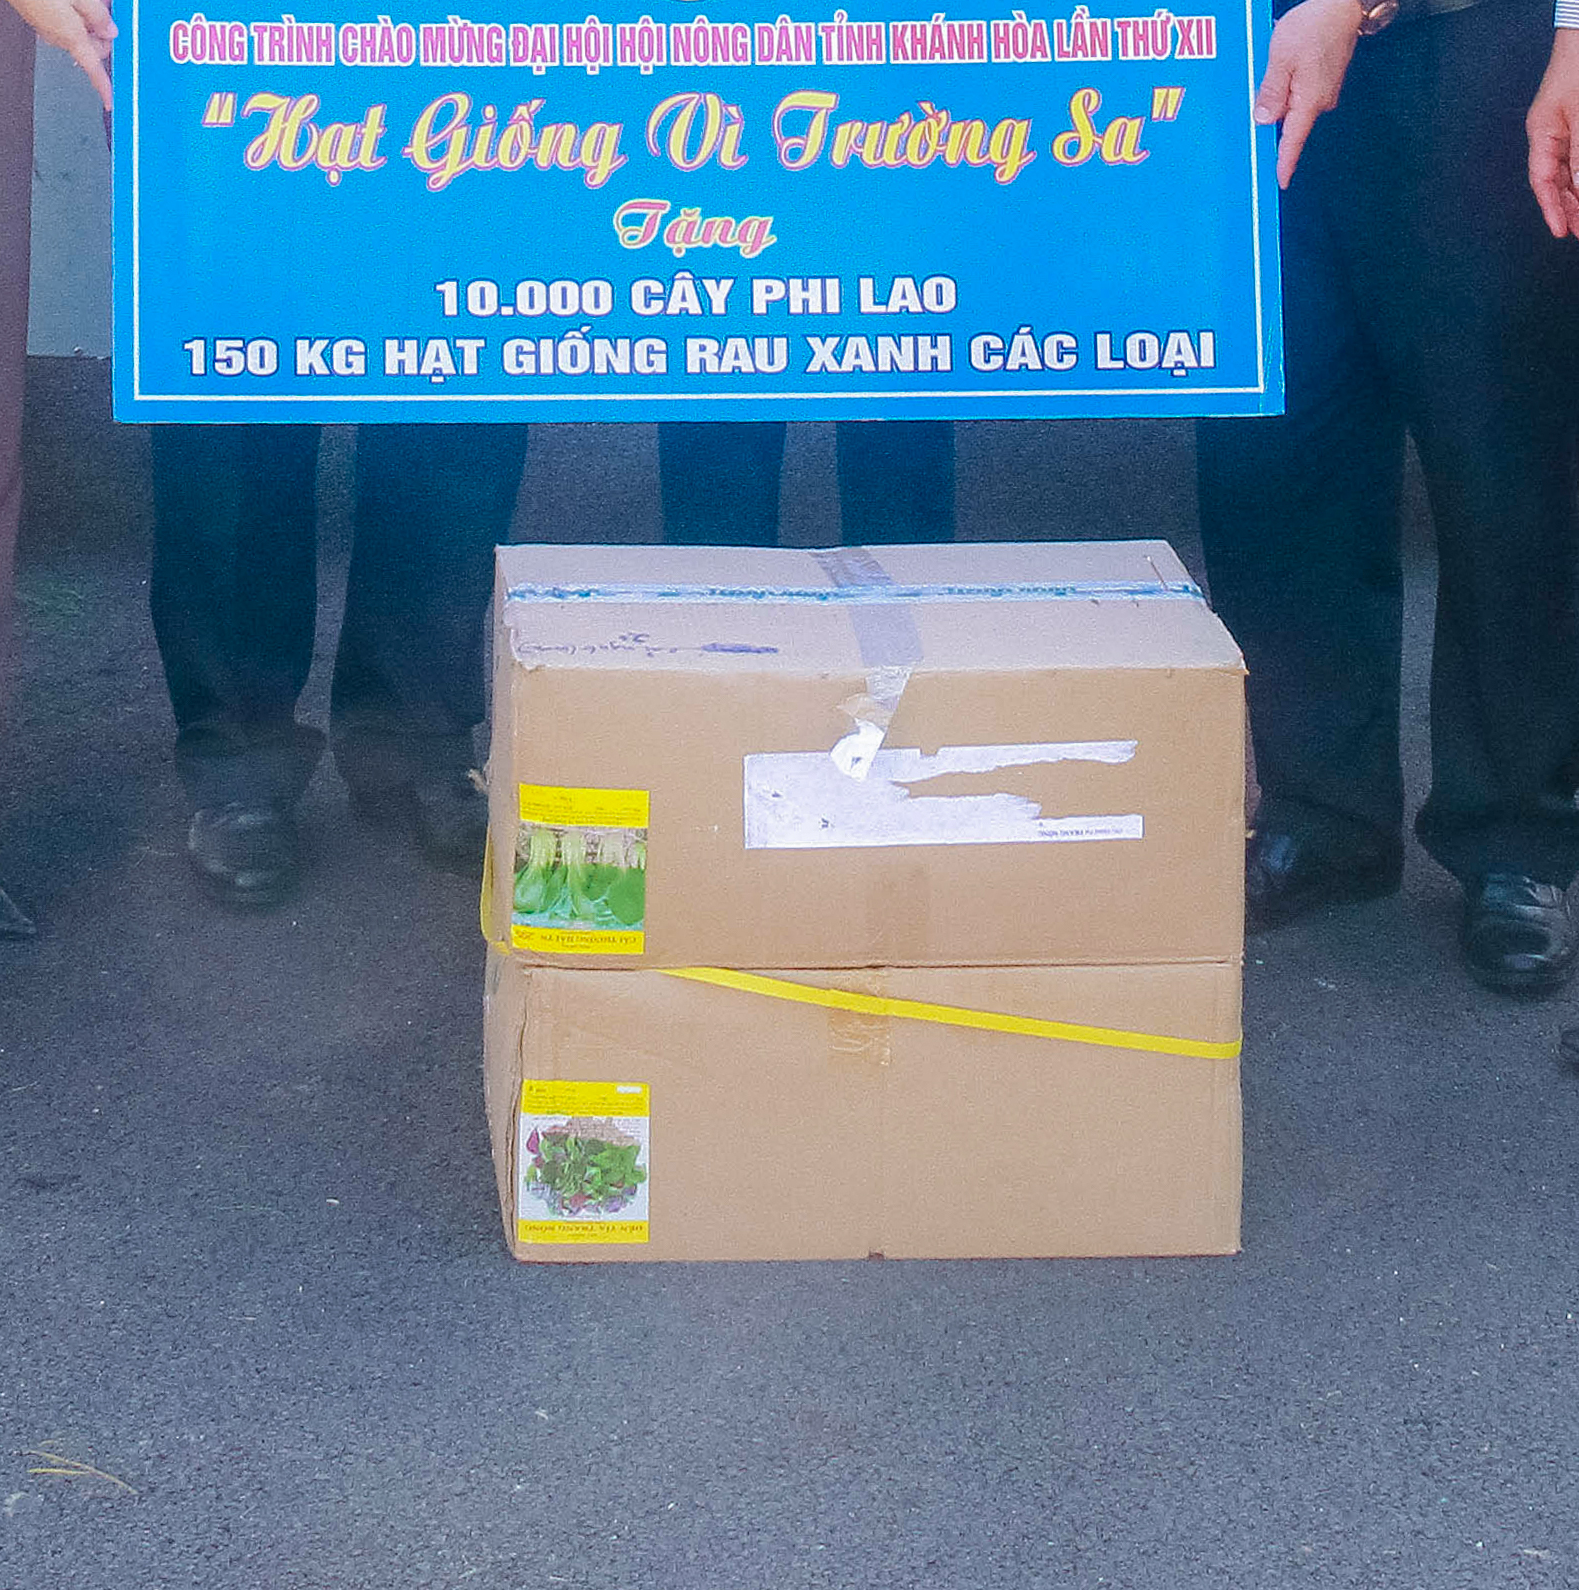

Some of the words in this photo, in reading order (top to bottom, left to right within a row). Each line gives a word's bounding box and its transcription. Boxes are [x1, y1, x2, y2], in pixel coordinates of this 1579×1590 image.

[169, 13, 248, 65] CÔNG
[249, 14, 336, 66] TRÌNH
[338, 15, 416, 67] CHÀO
[419, 15, 506, 67] MỪNG
[508, 24, 560, 75] ĐẠI
[563, 15, 613, 75] HỘI
[616, 15, 667, 75] HỘI
[669, 15, 752, 66] NÔNG
[754, 14, 816, 65] DÂN
[818, 9, 886, 65] TỈNH
[889, 13, 988, 64] KHÁNH
[990, 10, 1052, 63] HÒA
[1053, 5, 1112, 61] LẦN
[1114, 9, 1177, 60] THỨ
[1177, 16, 1217, 59] XII
[401, 92, 629, 192] Giống
[645, 92, 749, 172] Vì
[772, 90, 1037, 185] Trường
[613, 199, 777, 258] Tặng
[436, 280, 612, 316] 10.000
[632, 272, 734, 315] CÂY
[753, 278, 840, 315] PHI
[860, 277, 956, 314] LAO
[185, 340, 277, 375] 150
[297, 340, 365, 375] KG
[385, 339, 485, 382] HẠT
[503, 326, 666, 375] GIỐNG
[687, 338, 787, 373] RAU
[806, 336, 951, 372] XANH
[971, 327, 1076, 371] CÁC
[1097, 332, 1214, 376] LOẠI
